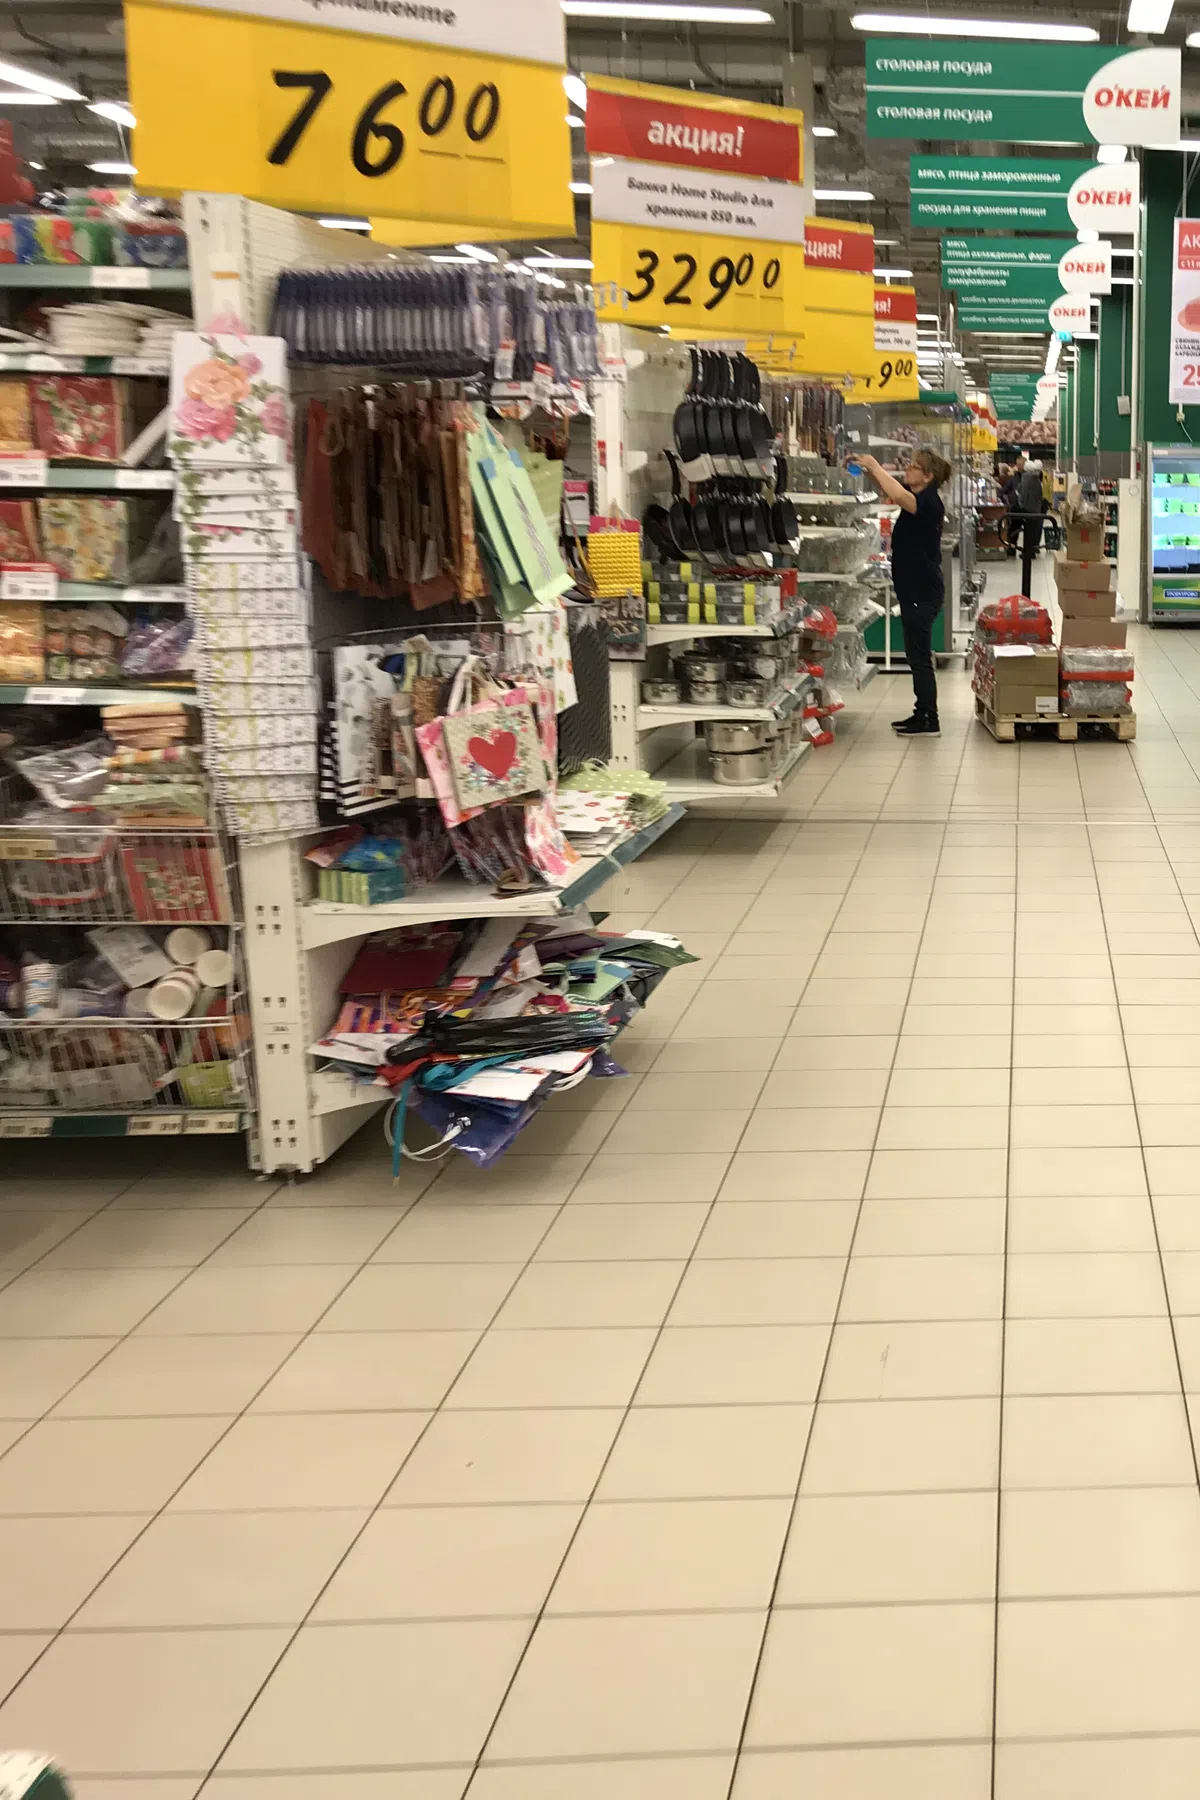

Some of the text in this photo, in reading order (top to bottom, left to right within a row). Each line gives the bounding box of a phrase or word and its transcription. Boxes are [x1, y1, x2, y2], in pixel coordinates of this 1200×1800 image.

[875, 58, 993, 77] столовая посуда
[876, 105, 994, 124] столовая посуда
[647, 119, 745, 158] акция!
[948, 169, 980, 183] птица
[981, 170, 1061, 184] замороженные
[627, 176, 774, 208] Банка Home Studio для
[645, 202, 708, 221] хранения
[918, 203, 1047, 218] посуда для хранения пищи
